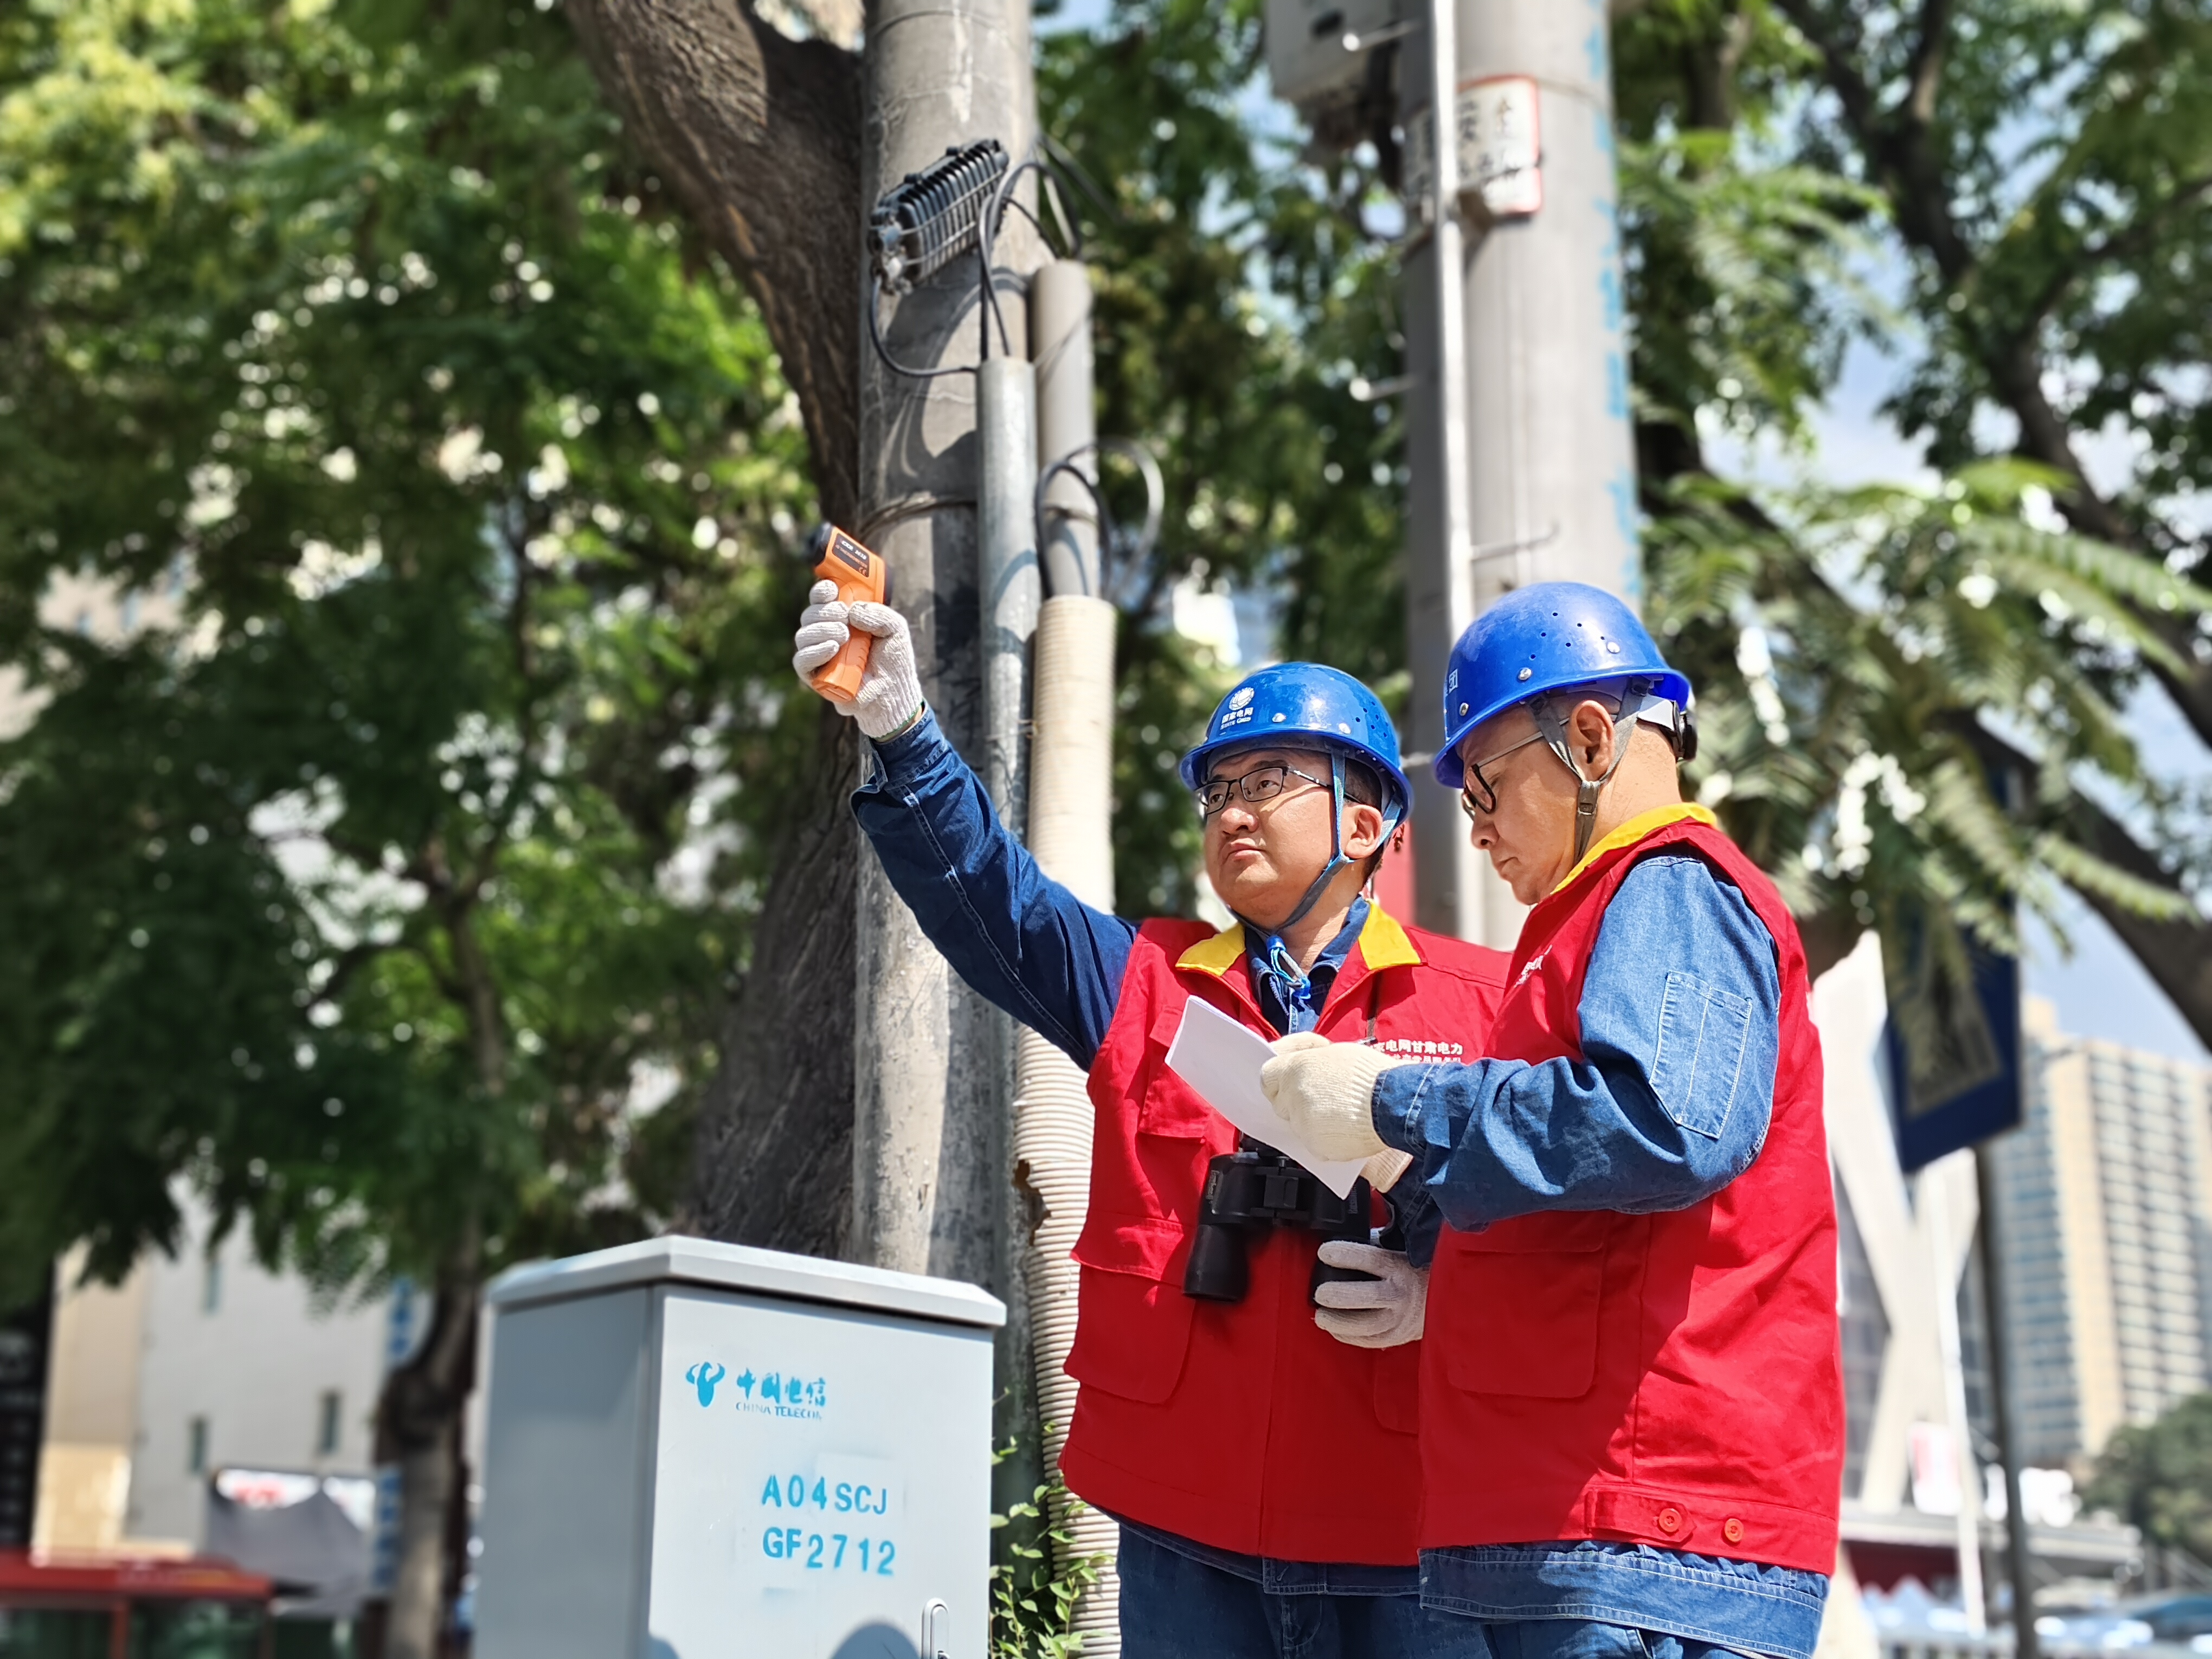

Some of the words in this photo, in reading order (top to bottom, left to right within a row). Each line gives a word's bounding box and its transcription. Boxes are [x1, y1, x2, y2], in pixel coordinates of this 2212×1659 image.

[1370, 1039, 1463, 1055] 家电网甘肃电力
[736, 1367, 827, 1407] 中国电信
[736, 1402, 771, 1414] CHINA
[762, 1474, 888, 1515] A04SCJ
[763, 1526, 896, 1576] GF2712
